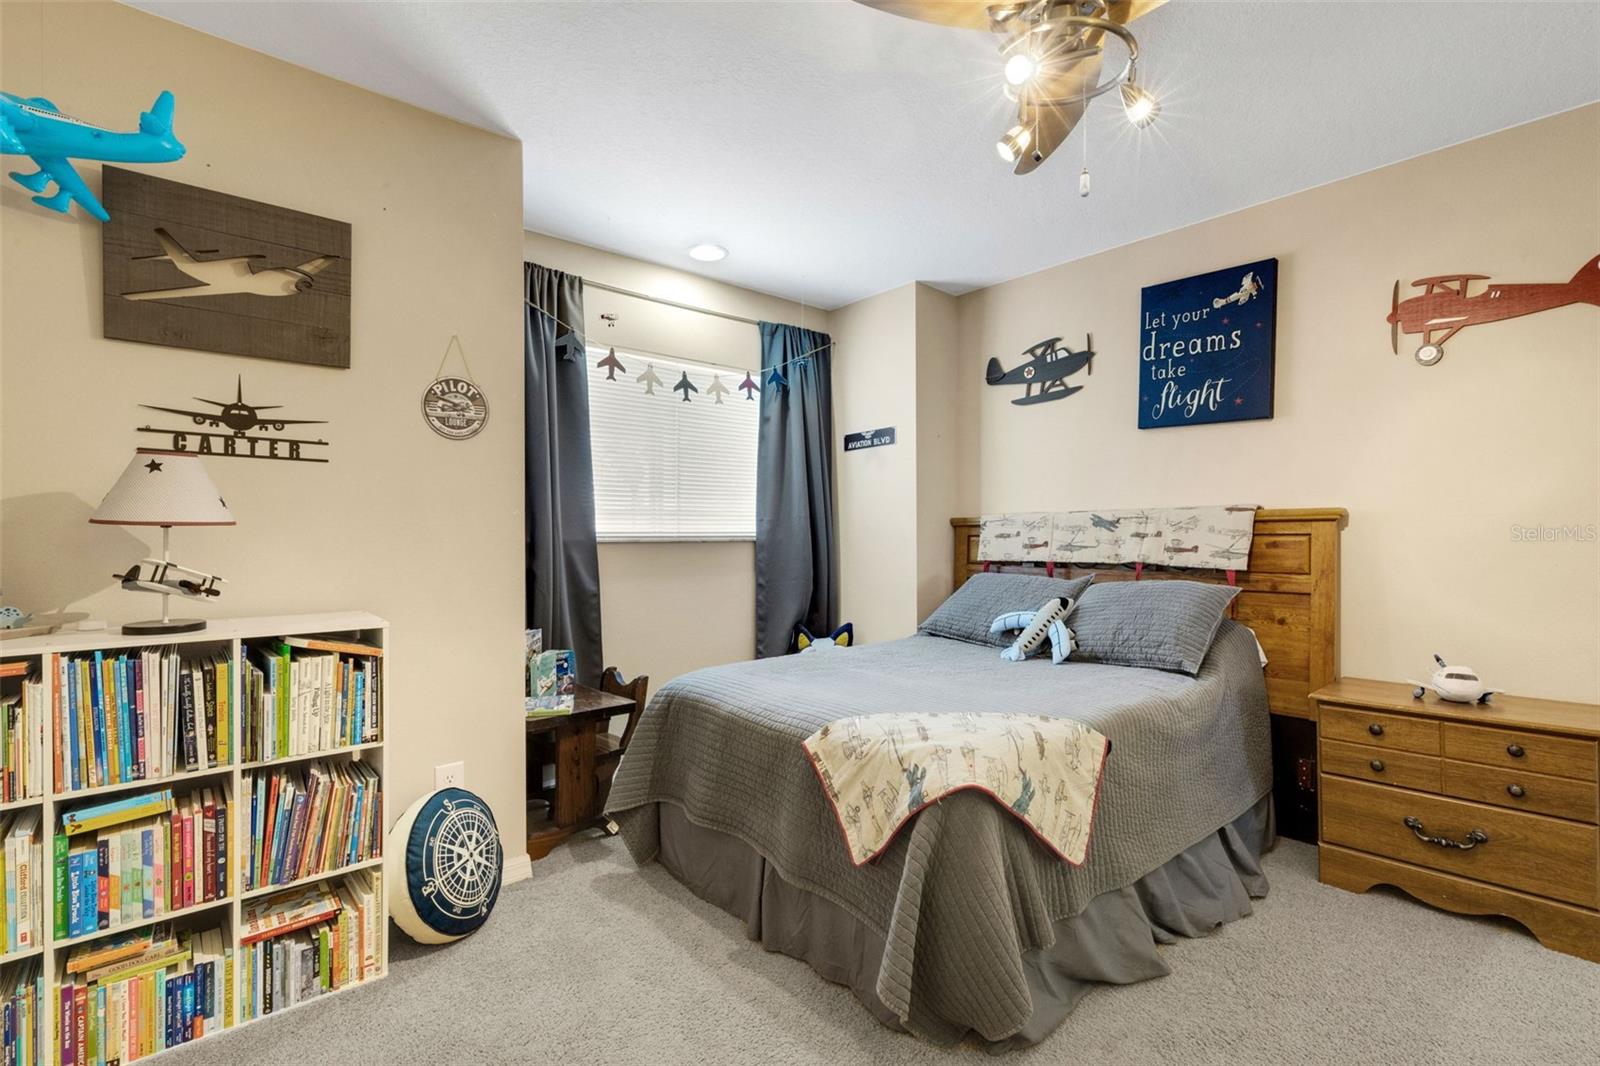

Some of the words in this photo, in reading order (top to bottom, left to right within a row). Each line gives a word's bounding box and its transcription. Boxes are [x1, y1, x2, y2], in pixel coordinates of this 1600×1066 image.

[1144, 312, 1166, 330] Let
[1172, 308, 1210, 330] your
[1143, 330, 1242, 361] dreams
[1152, 358, 1186, 380] take
[432, 380, 478, 397] PILOT
[1152, 378, 1232, 420] flight
[173, 433, 301, 460] CARTER
[848, 438, 872, 450] AVIATION
[873, 436, 891, 446] BLVD
[443, 798, 453, 811] S
[422, 882, 437, 897] E
[72, 902, 80, 924] Truck
[77, 1016, 85, 1041] CAPTAIN
